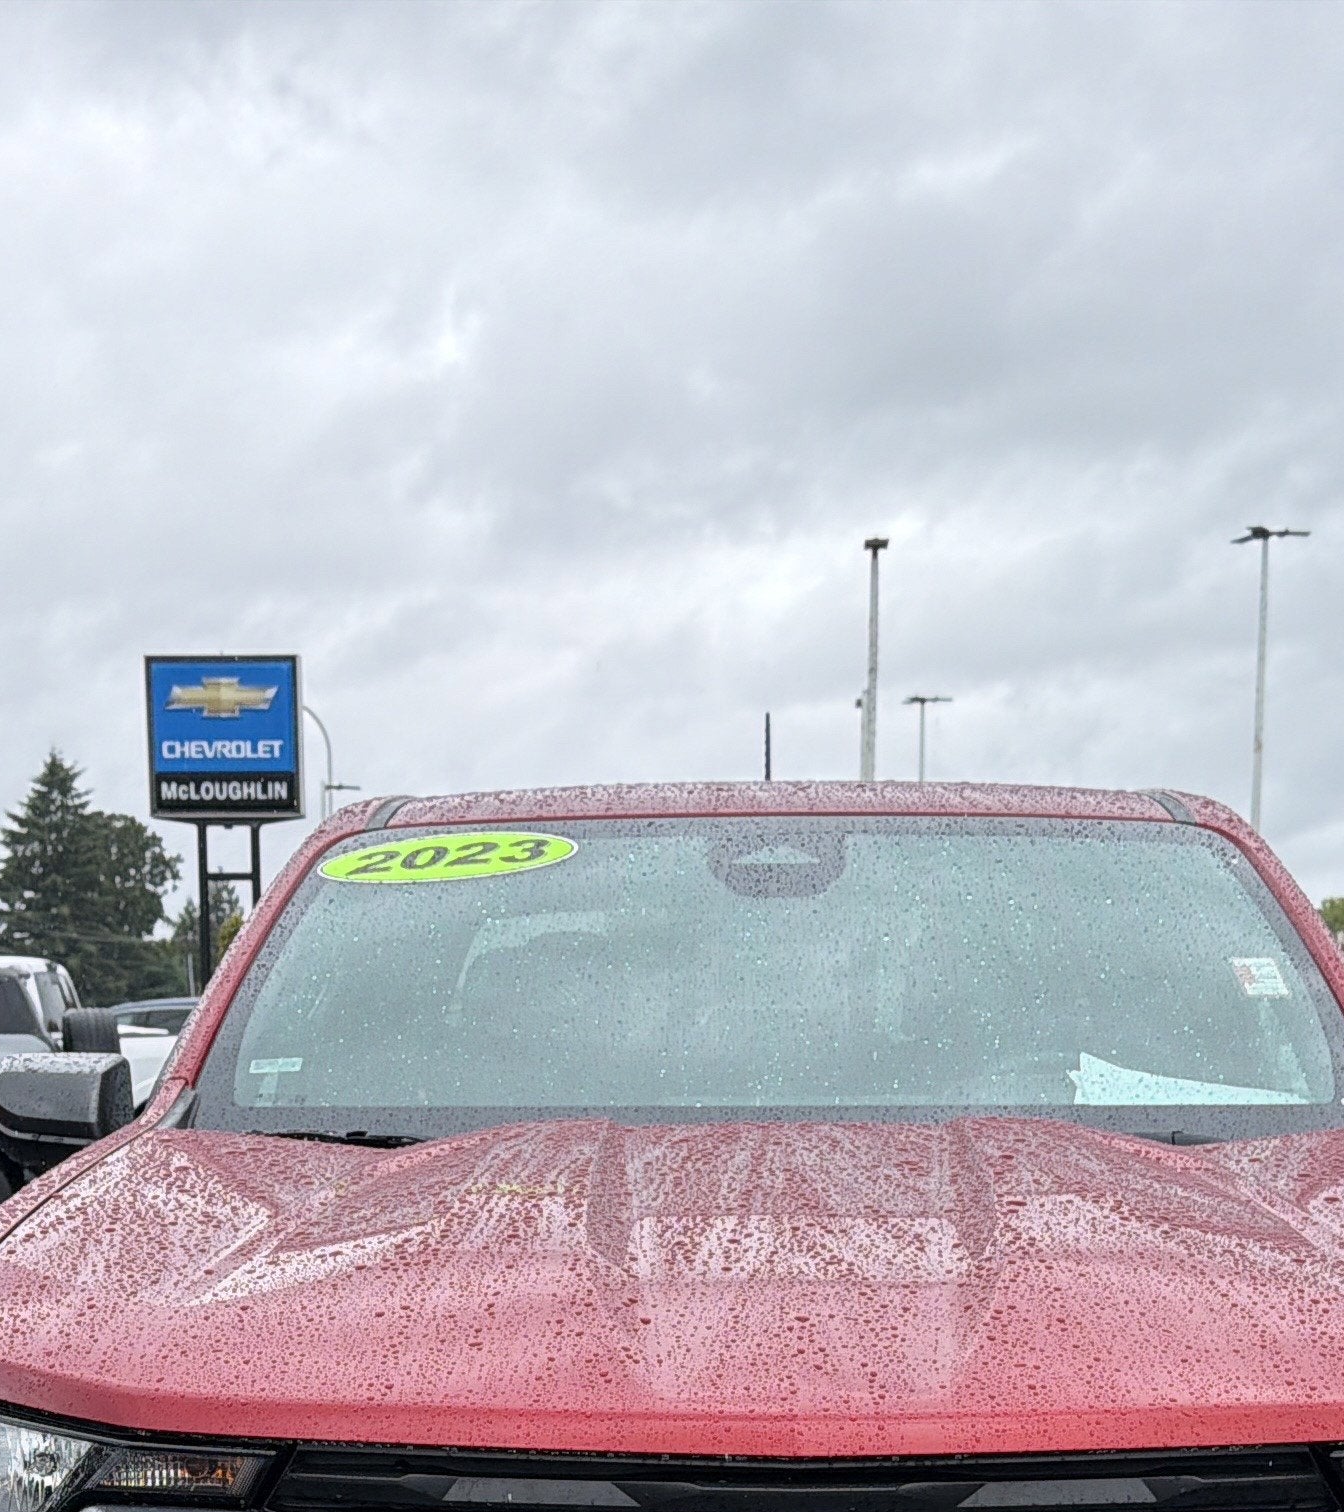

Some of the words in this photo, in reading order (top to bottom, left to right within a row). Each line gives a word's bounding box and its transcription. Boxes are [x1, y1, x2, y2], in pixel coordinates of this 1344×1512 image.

[161, 739, 284, 759] CHEVROLET
[160, 780, 288, 801] McLOUGHLIN
[345, 839, 551, 877] 2023
